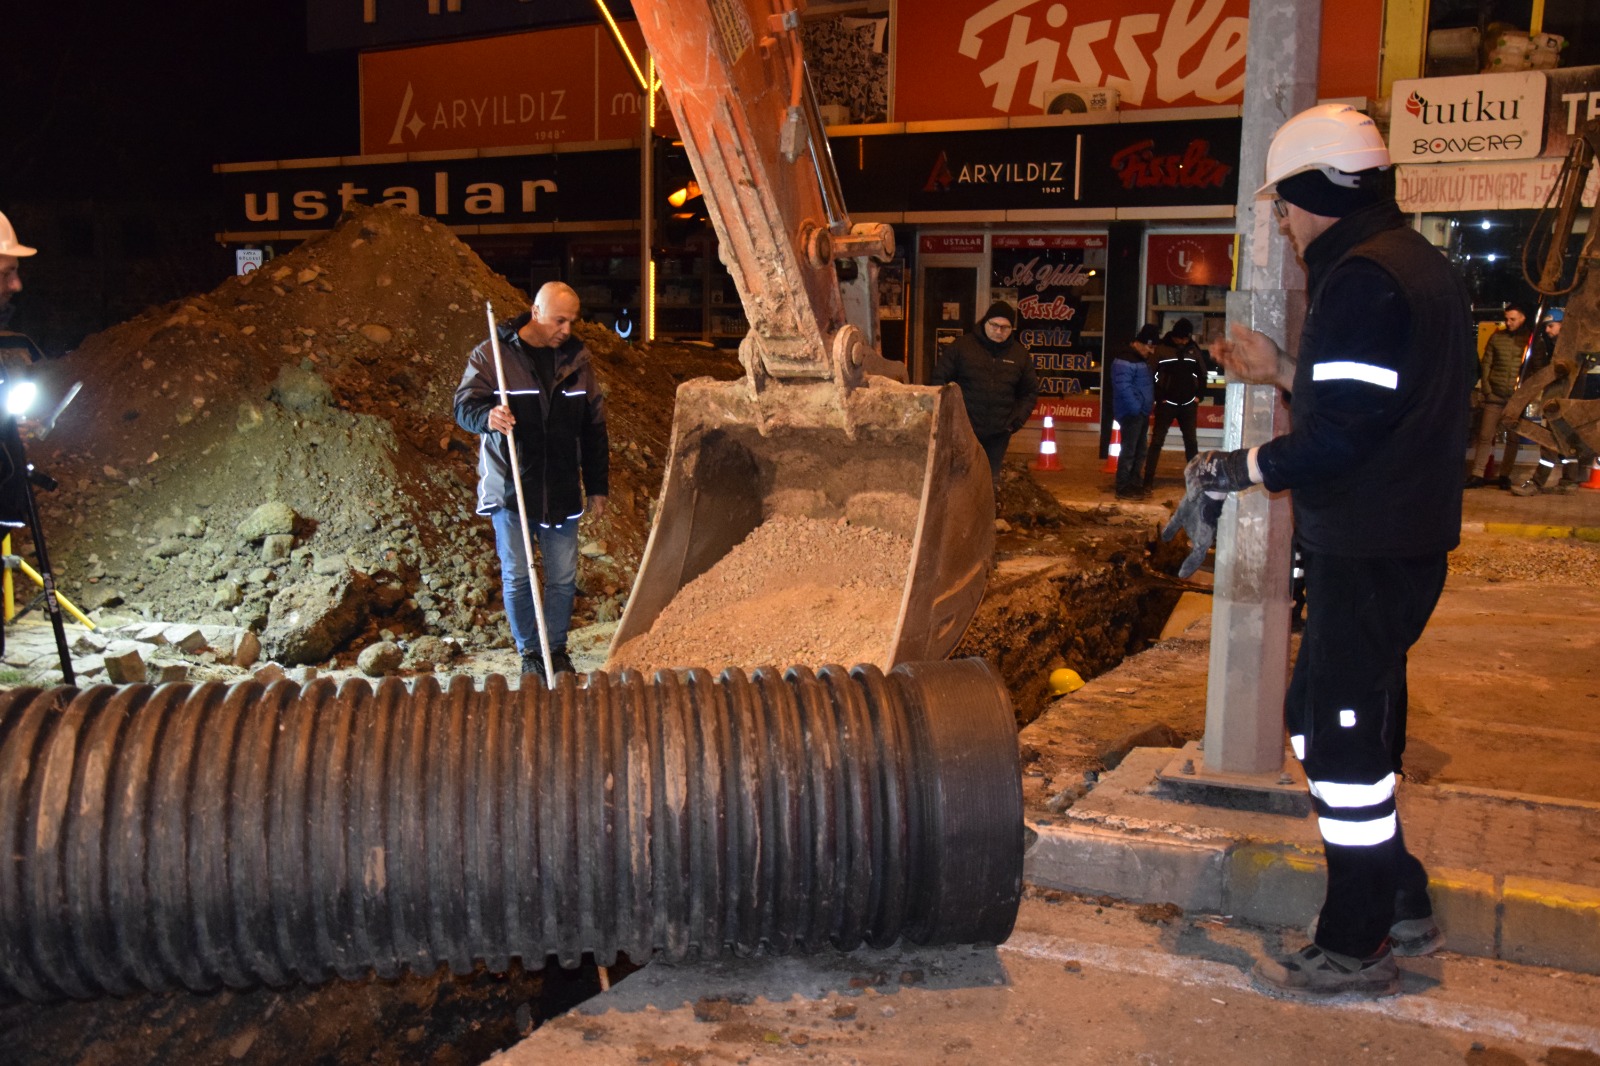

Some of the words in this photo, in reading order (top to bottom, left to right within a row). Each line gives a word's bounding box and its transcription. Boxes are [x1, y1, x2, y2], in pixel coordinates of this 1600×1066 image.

[432, 89, 567, 130] ARYILDIZ
[1421, 91, 1520, 125] tutku
[1412, 134, 1523, 155] BONERA
[958, 162, 1063, 183] ARYILDIZ
[1111, 138, 1232, 190] Fissler
[244, 171, 559, 222] ustalar
[943, 237, 982, 246] USTALAR
[1018, 295, 1076, 320] Fissler
[1020, 327, 1072, 350] ÇEYİZ
[1030, 352, 1094, 371] ETLERİ
